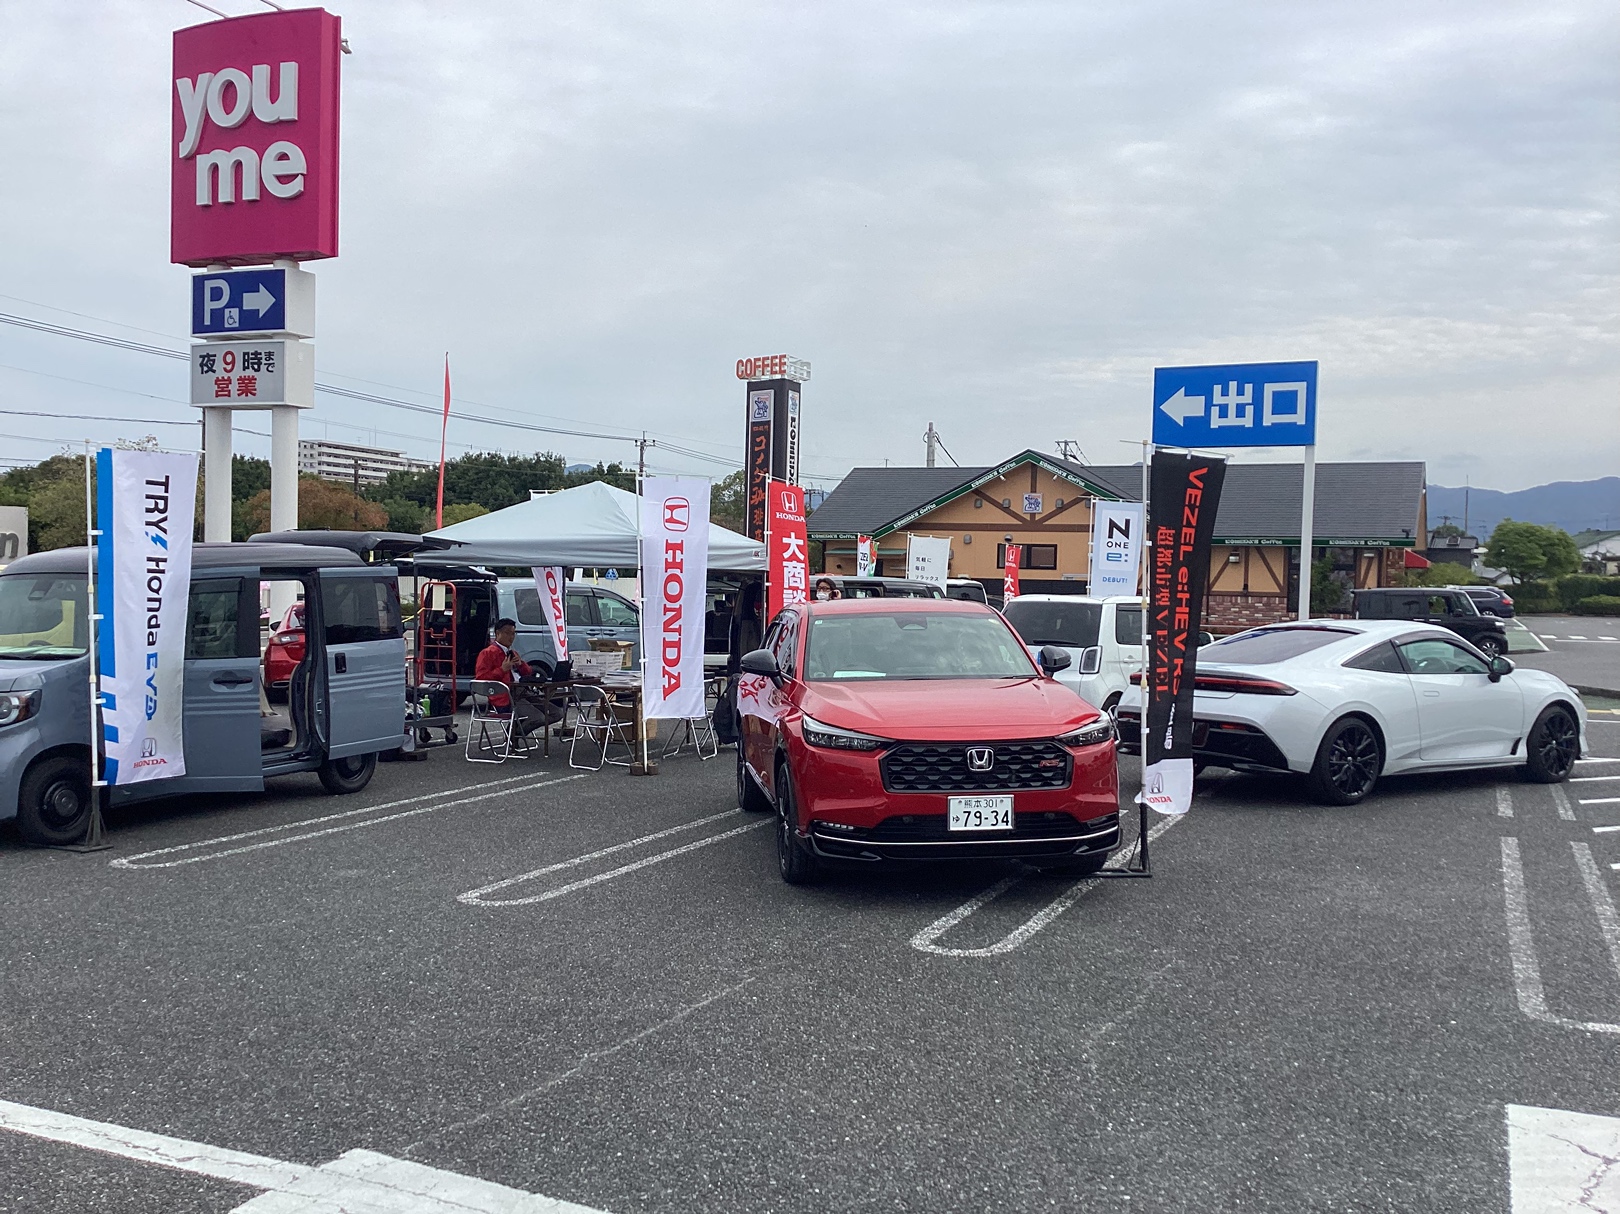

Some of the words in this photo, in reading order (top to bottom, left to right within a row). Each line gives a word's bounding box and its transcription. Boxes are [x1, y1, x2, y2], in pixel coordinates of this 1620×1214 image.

[175, 61, 298, 159] you
[195, 140, 307, 207] me
[203, 279, 231, 326] P
[735, 353, 787, 380] COFFEE
[214, 375, 258, 398] 営業
[1210, 380, 1308, 429] 出口
[145, 475, 170, 535] TRY
[775, 512, 806, 523] HONDA
[1179, 467, 1209, 561] VEZEL
[1107, 517, 1131, 540] N
[1106, 541, 1130, 549] ONE
[1102, 576, 1128, 584] DEBUT!
[146, 556, 168, 646] Honda
[662, 539, 685, 701] HONDA
[133, 758, 168, 769] HONDA
[983, 799, 998, 808] 301
[962, 810, 1010, 828] 79-34
